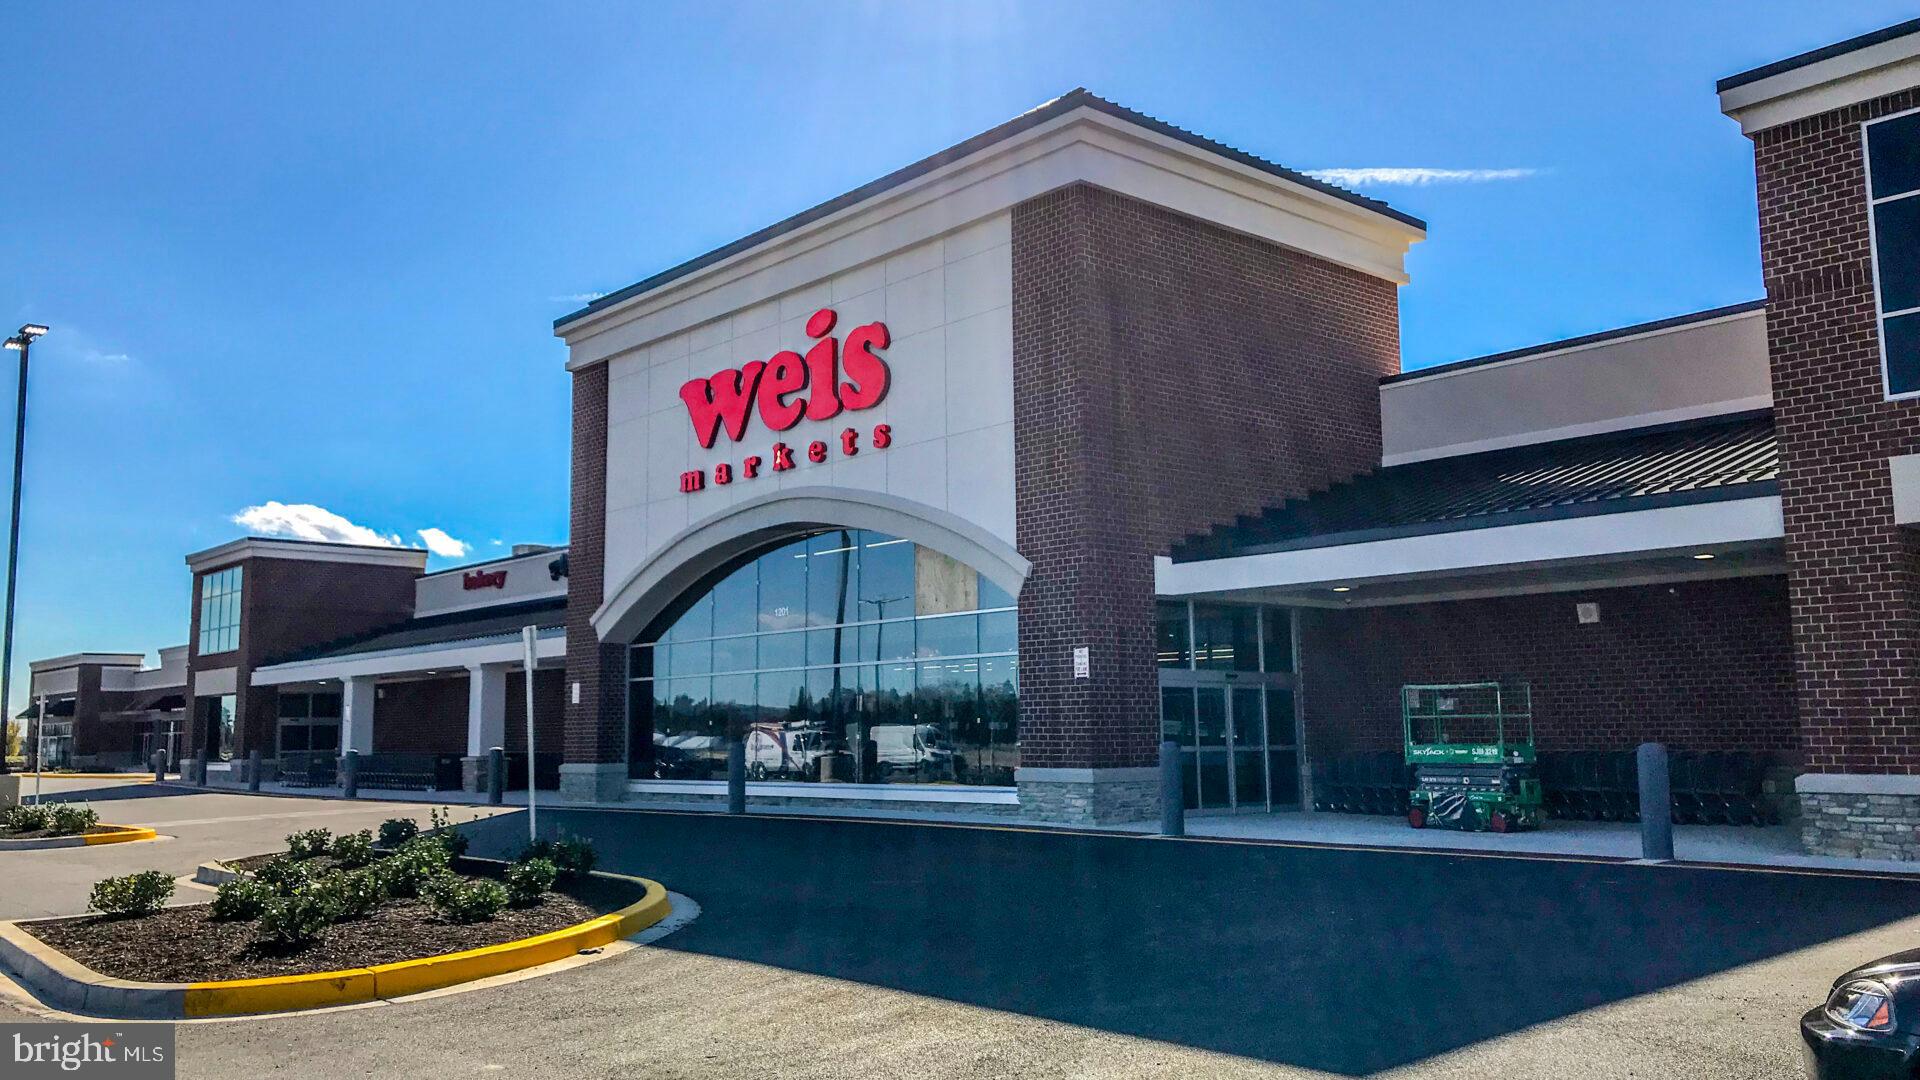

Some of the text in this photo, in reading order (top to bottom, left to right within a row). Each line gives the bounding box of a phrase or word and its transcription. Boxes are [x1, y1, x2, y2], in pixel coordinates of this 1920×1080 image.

[679, 308, 891, 449] weis
[680, 424, 891, 493] markets
[774, 606, 789, 617] 1201
